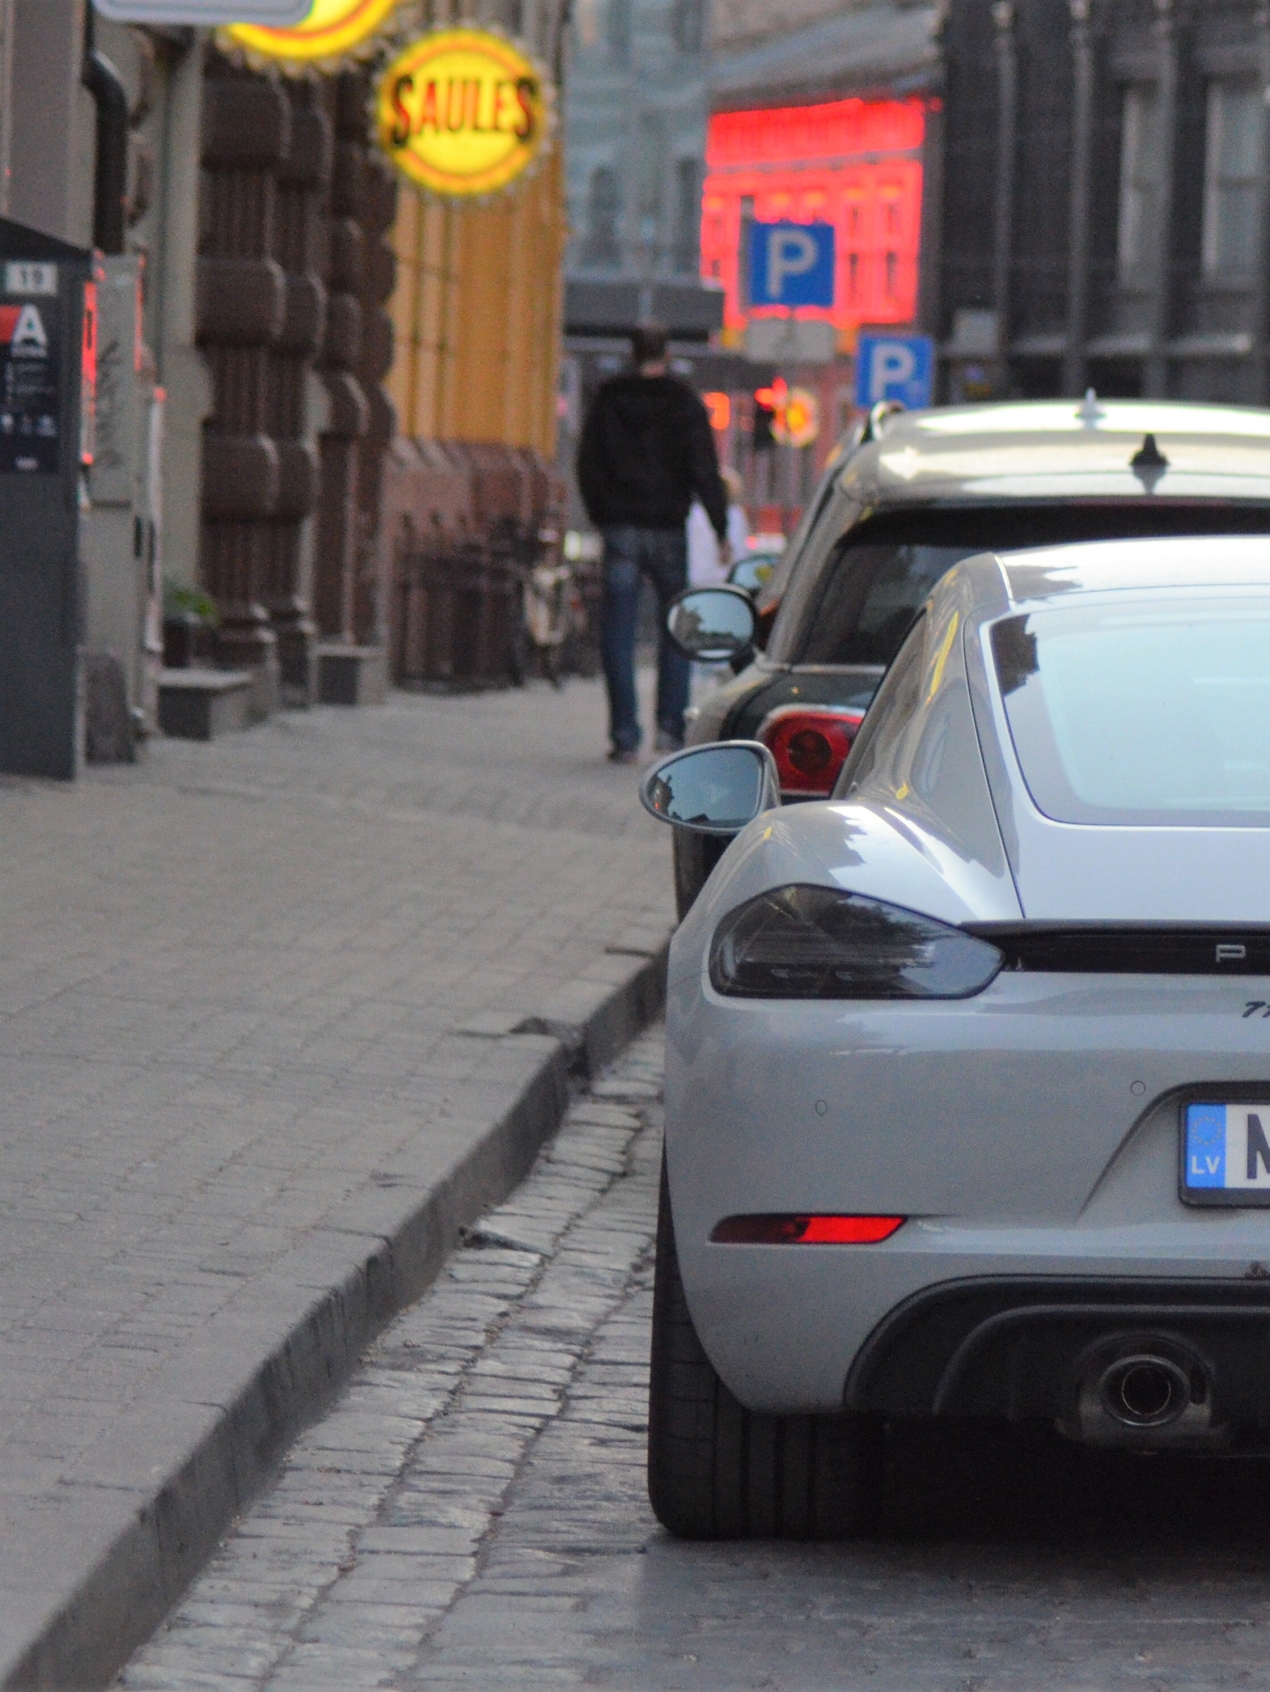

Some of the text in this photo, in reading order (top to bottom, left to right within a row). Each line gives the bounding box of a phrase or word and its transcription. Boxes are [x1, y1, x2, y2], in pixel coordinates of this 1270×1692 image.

[391, 74, 536, 147] SAULES
[766, 229, 818, 299] P
[869, 341, 916, 402] P
[1191, 1156, 1221, 1176] LV
